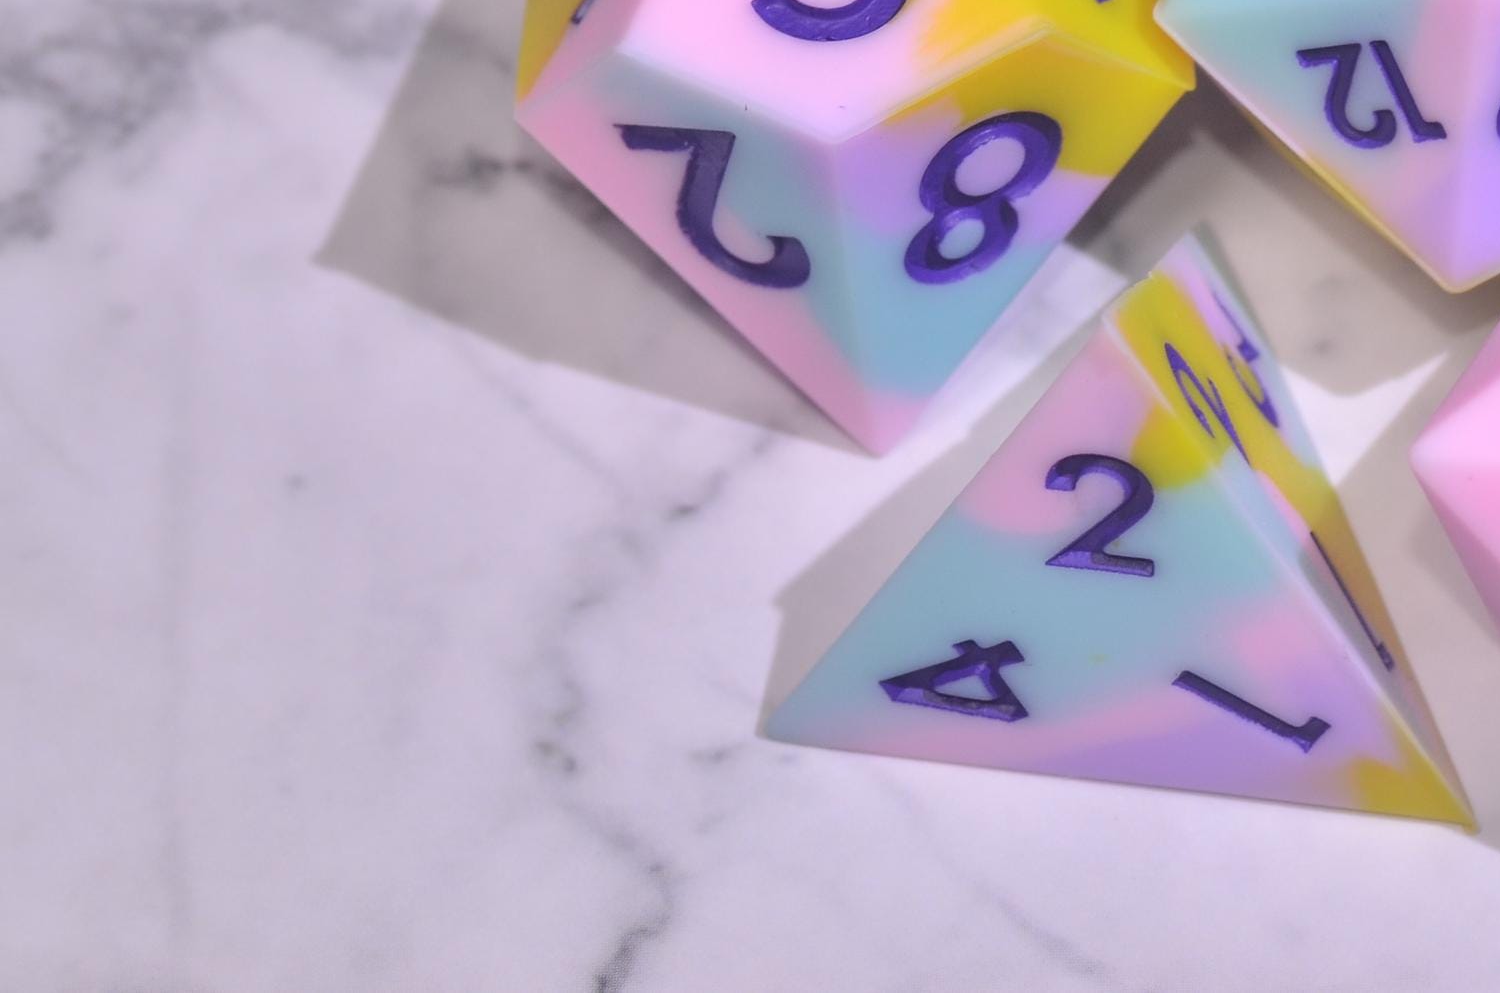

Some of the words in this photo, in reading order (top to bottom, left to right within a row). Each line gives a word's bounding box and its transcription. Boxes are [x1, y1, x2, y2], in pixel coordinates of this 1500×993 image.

[1295, 39, 1447, 148] 12
[613, 123, 811, 289] 2
[903, 110, 1062, 286] 8
[1163, 341, 1252, 466] 2
[1044, 453, 1155, 578] 2
[1309, 529, 1396, 673] 1
[878, 638, 1030, 723] 4
[1171, 669, 1332, 754] 1
